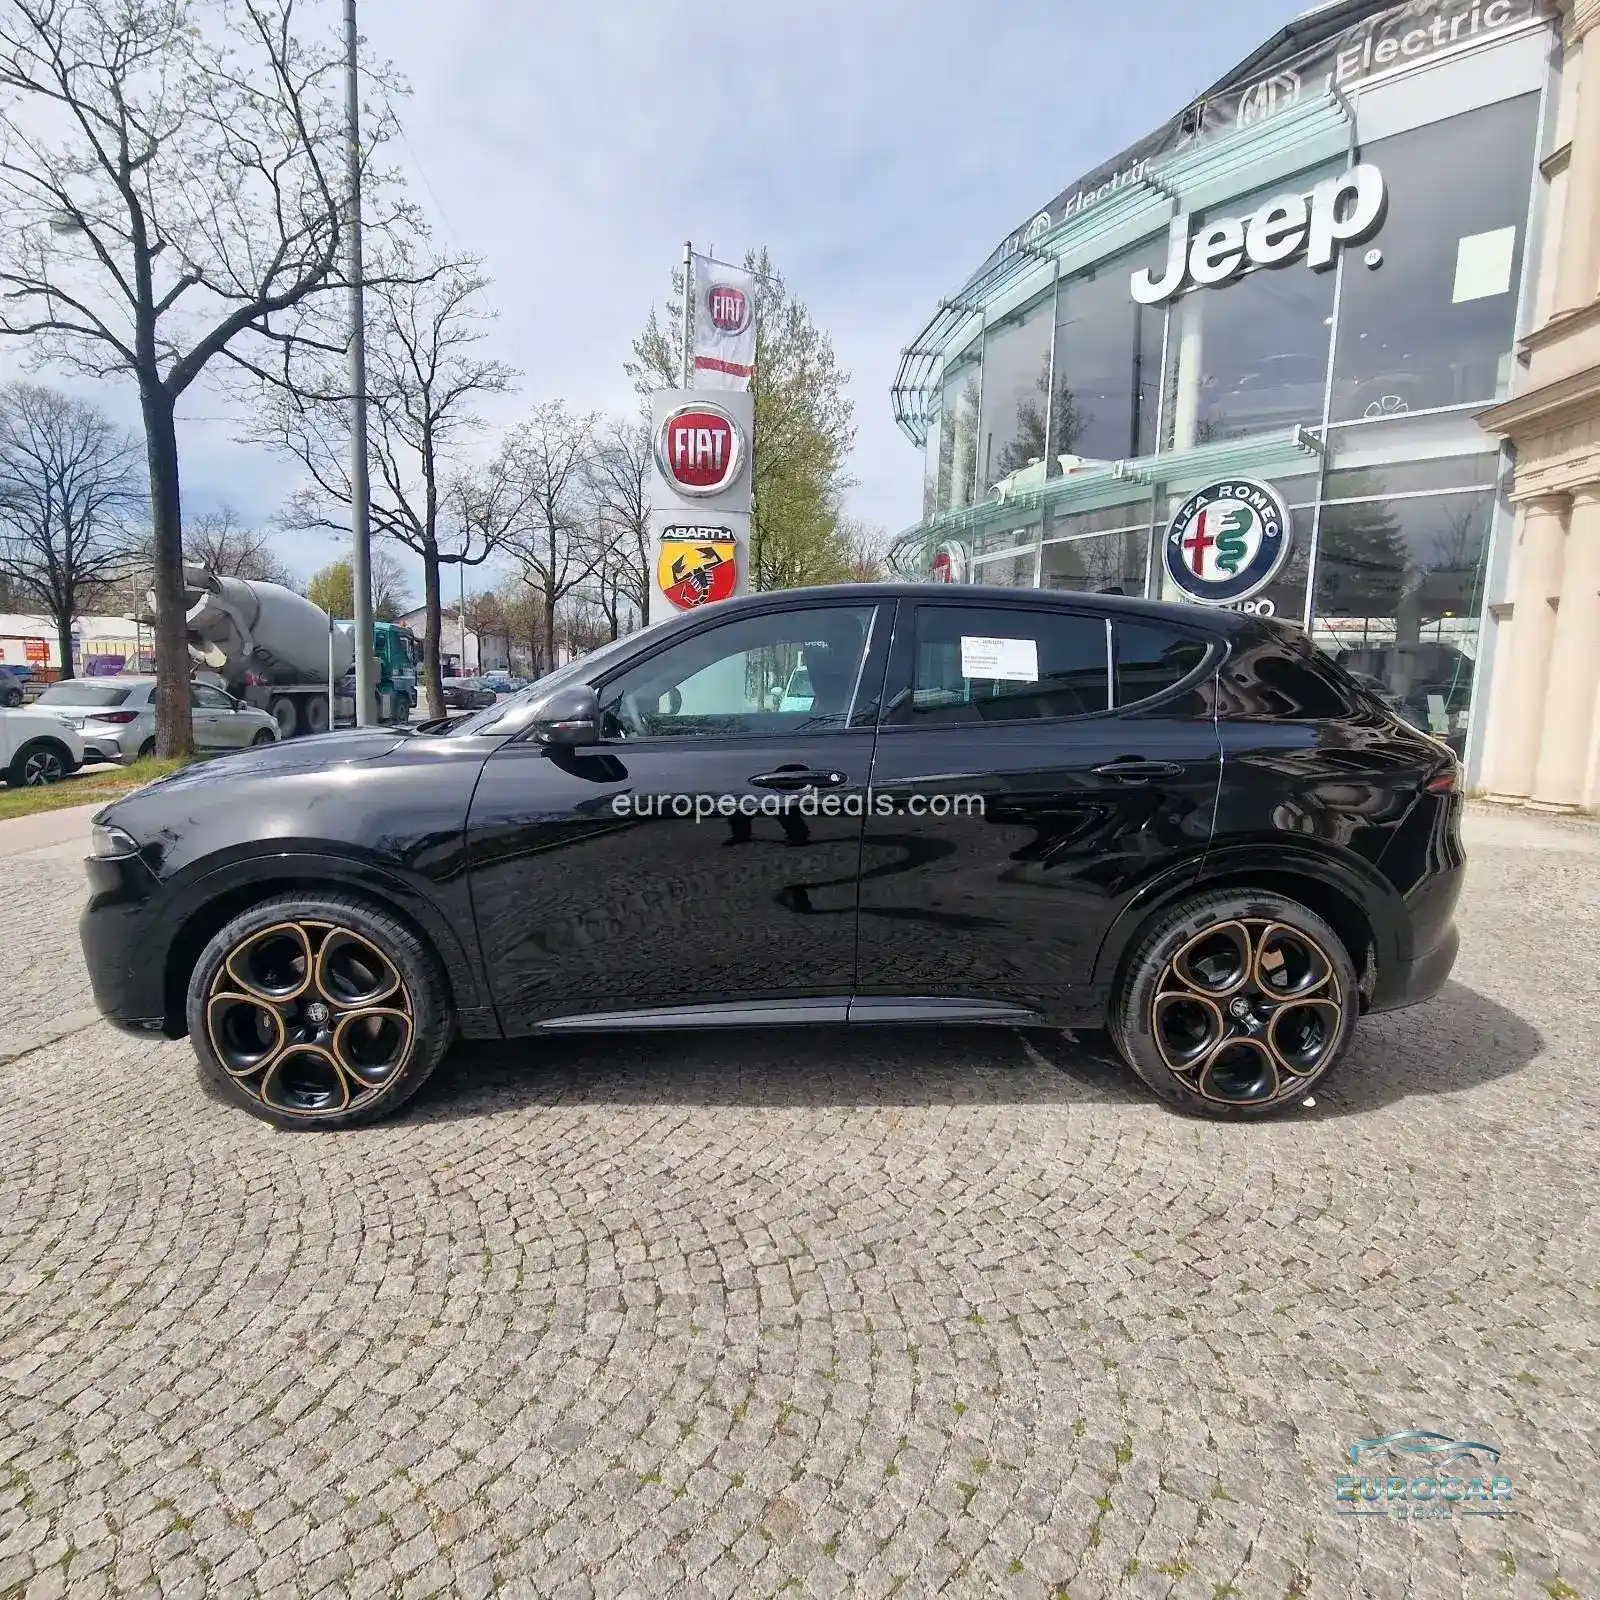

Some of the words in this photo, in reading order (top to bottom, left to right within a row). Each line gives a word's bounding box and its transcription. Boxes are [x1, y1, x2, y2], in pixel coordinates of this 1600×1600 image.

[1336, 0, 1510, 84] Electric
[1131, 163, 1384, 304] Jeep
[713, 295, 742, 322] FIAT
[675, 428, 726, 470] FIAT
[663, 527, 731, 539] ABARTH
[1170, 496, 1209, 546] ALFA
[1218, 486, 1279, 538] ROMEO
